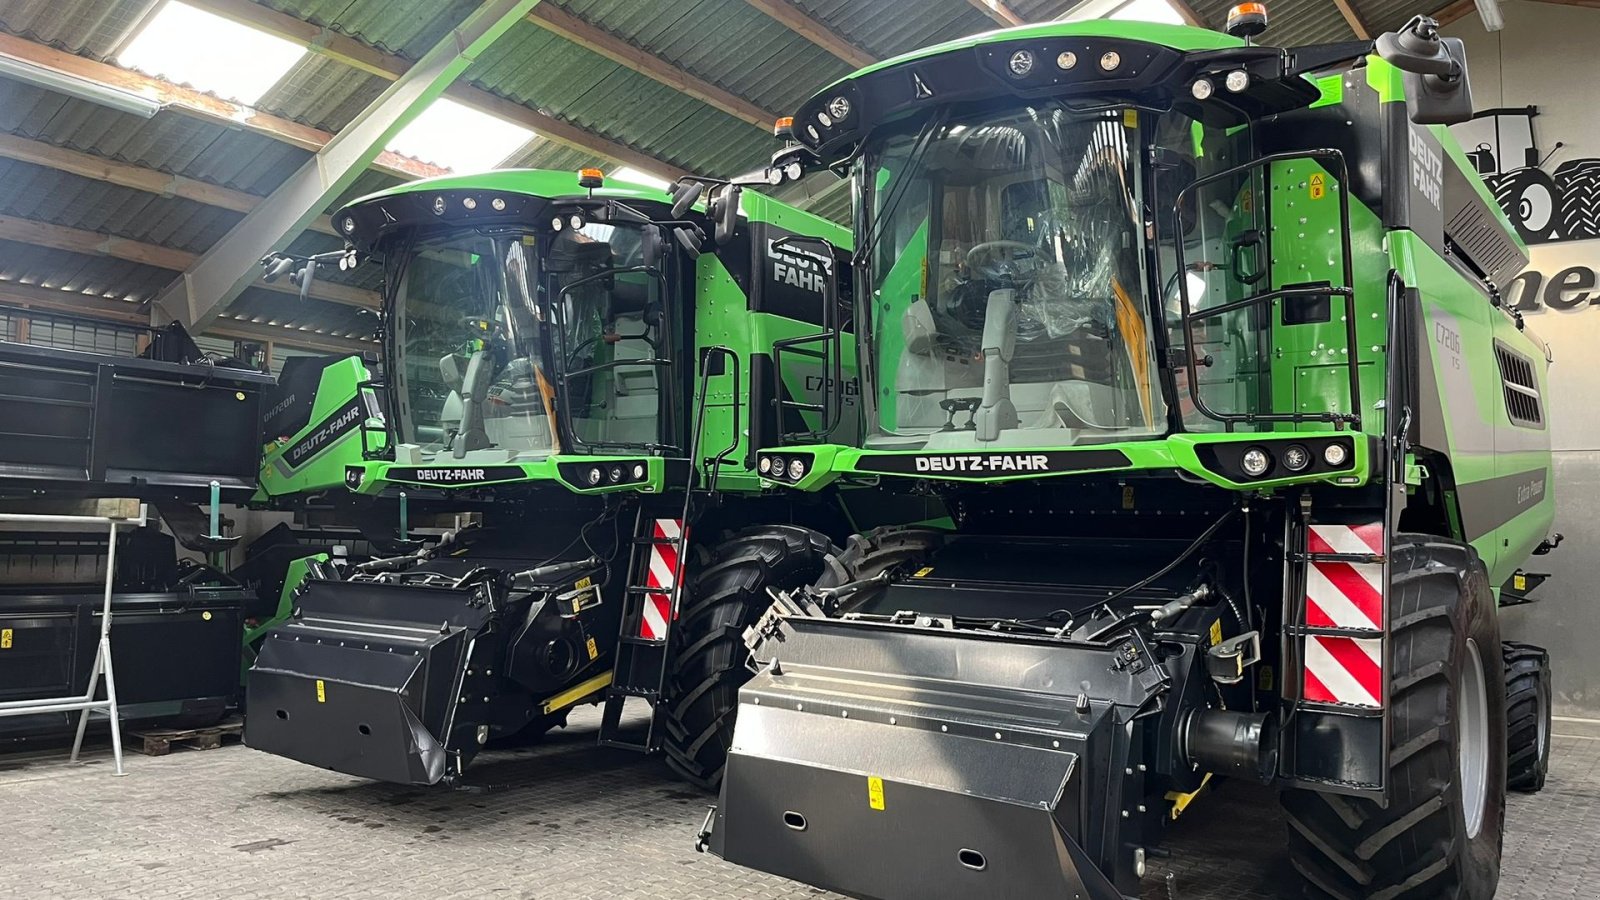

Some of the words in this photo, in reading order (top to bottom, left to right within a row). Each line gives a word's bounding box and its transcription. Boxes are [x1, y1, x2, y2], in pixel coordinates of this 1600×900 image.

[1409, 125, 1443, 186] DEUTZ
[1413, 159, 1440, 211] FAHR
[774, 262, 824, 294] FAHR
[1436, 321, 1460, 354] C7206
[1452, 356, 1460, 370] TS
[293, 406, 360, 460] DEUTZ-FAHR
[416, 468, 485, 480] DEUTZ-FAHR
[915, 455, 1049, 471] DEUTZ-FAHR
